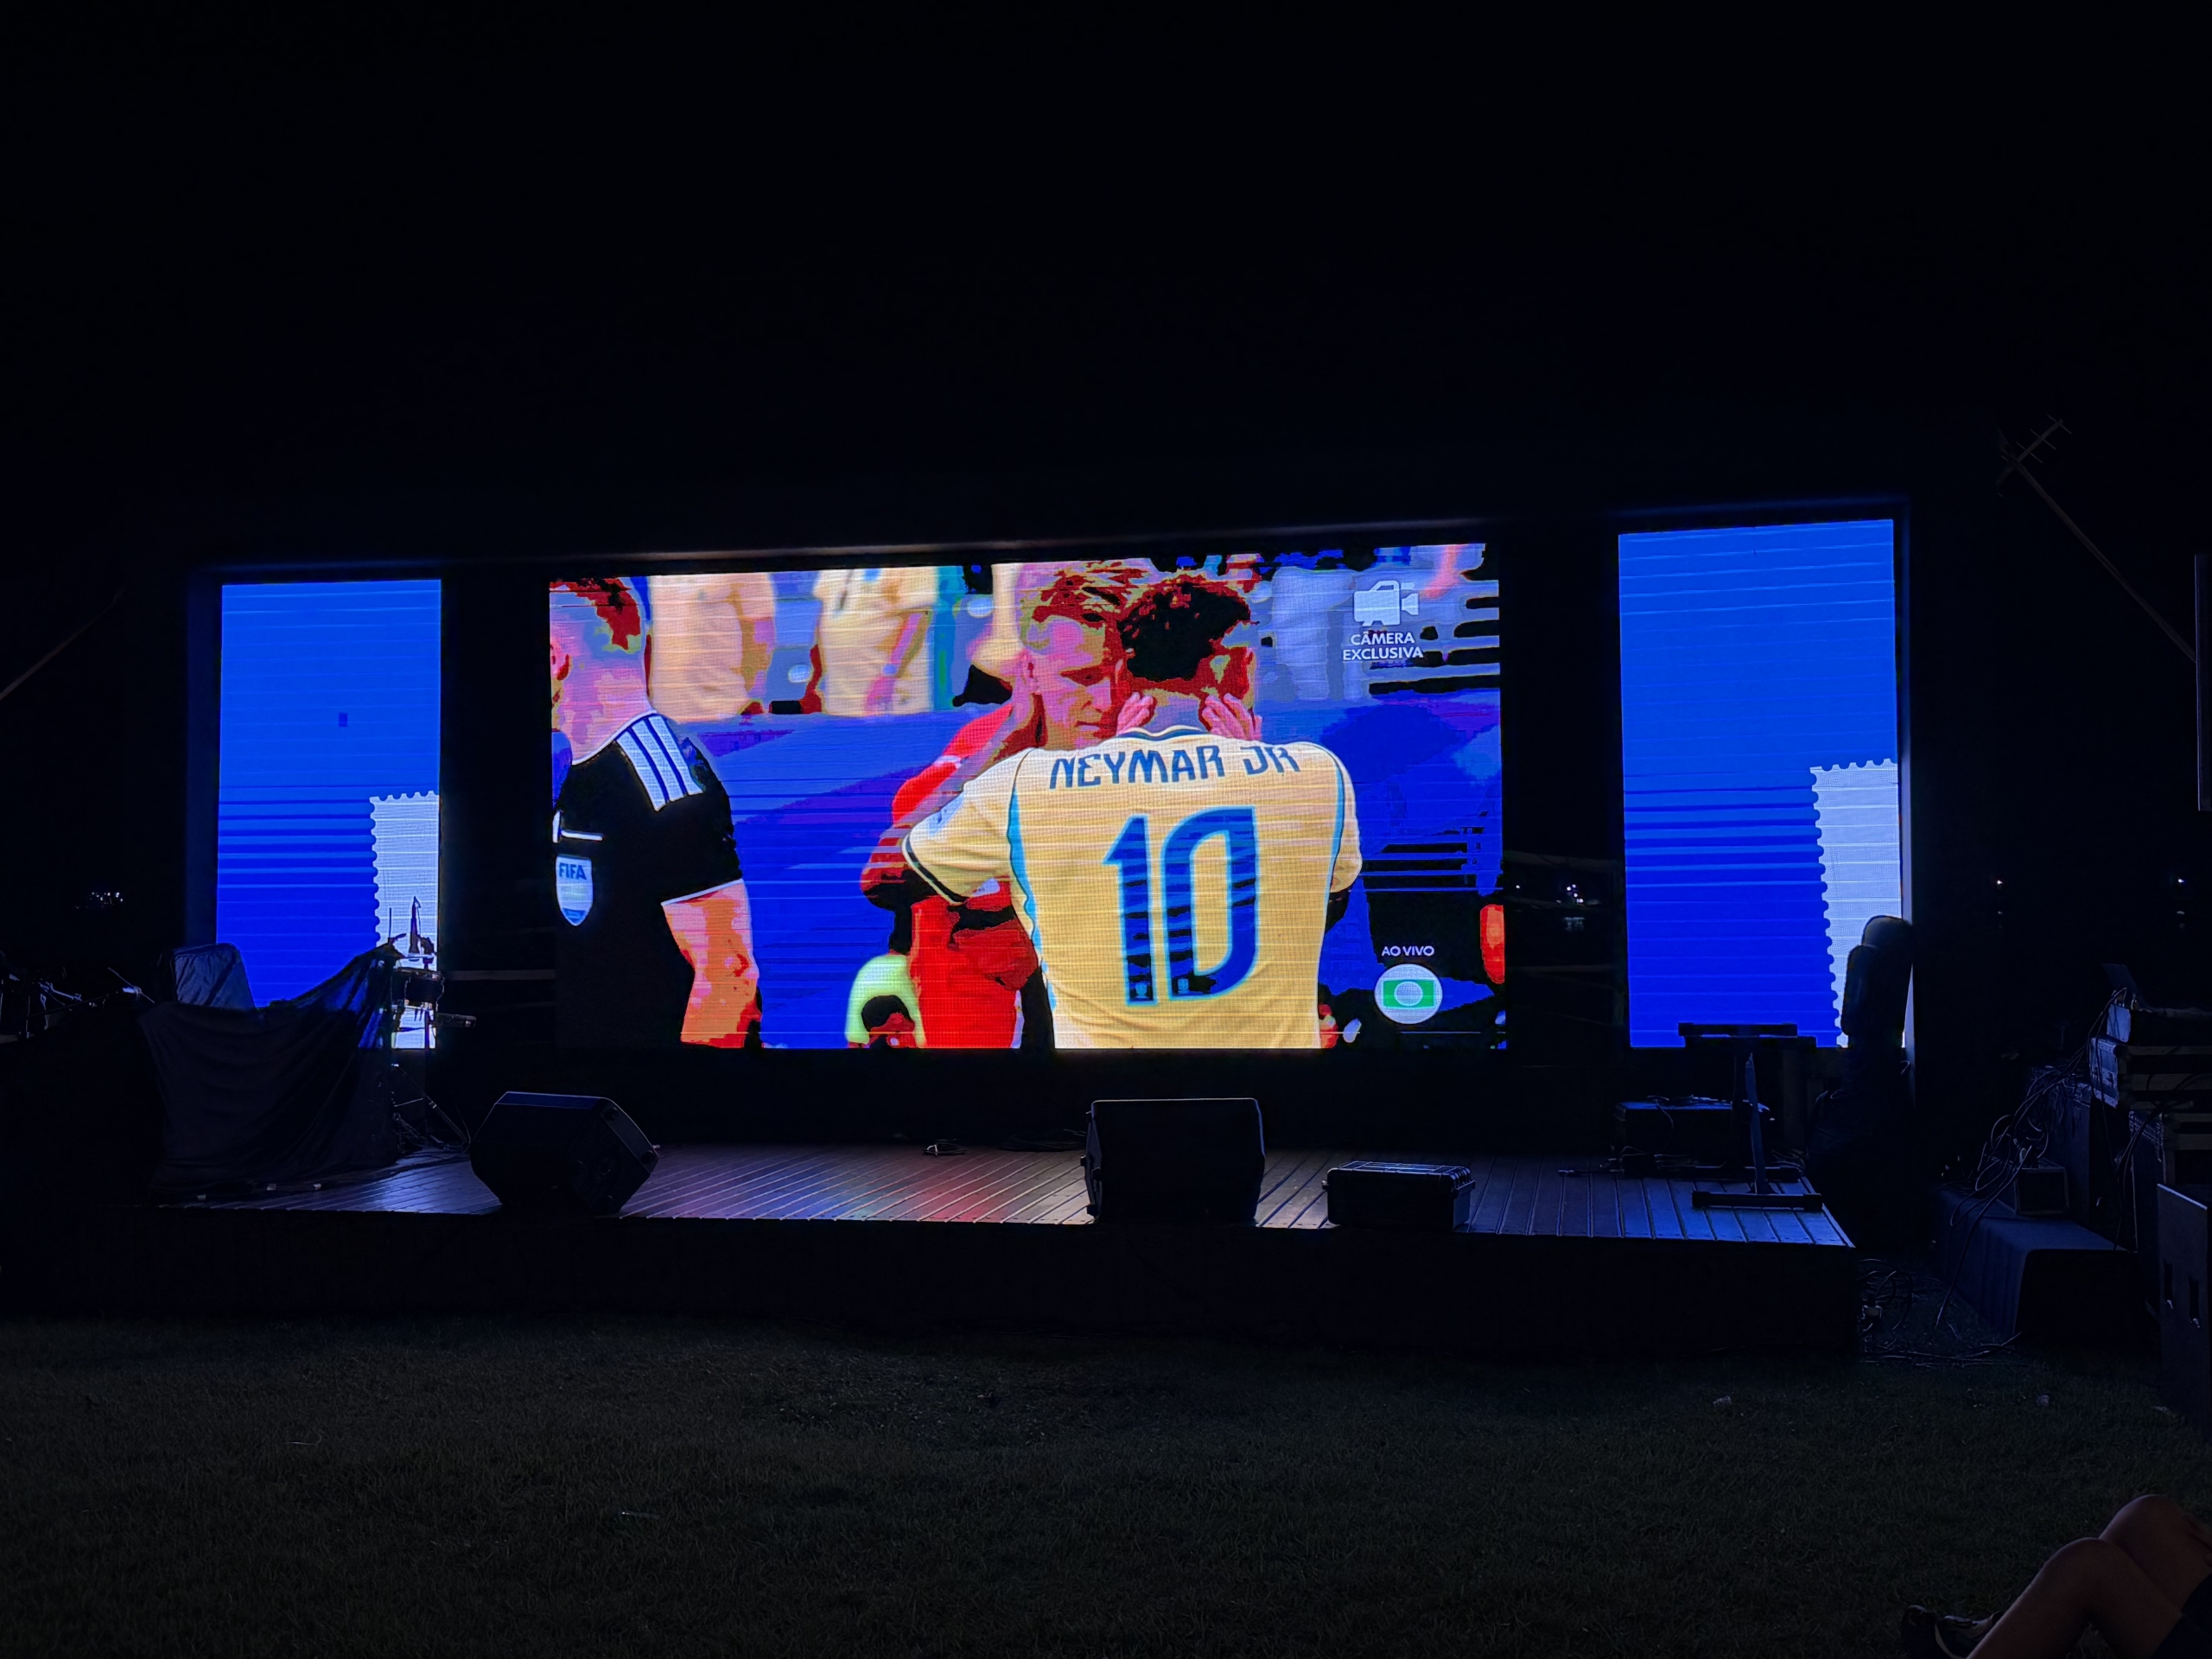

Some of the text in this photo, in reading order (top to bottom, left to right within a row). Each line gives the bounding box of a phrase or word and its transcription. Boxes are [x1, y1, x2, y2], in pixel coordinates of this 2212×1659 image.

[1343, 646, 1424, 661] EXCLUSIVA
[1049, 745, 1301, 790] NEYMAR JR
[559, 862, 587, 880] FIFA
[1102, 805, 1260, 1007] 10
[1381, 945, 1434, 957] AO VIVO
